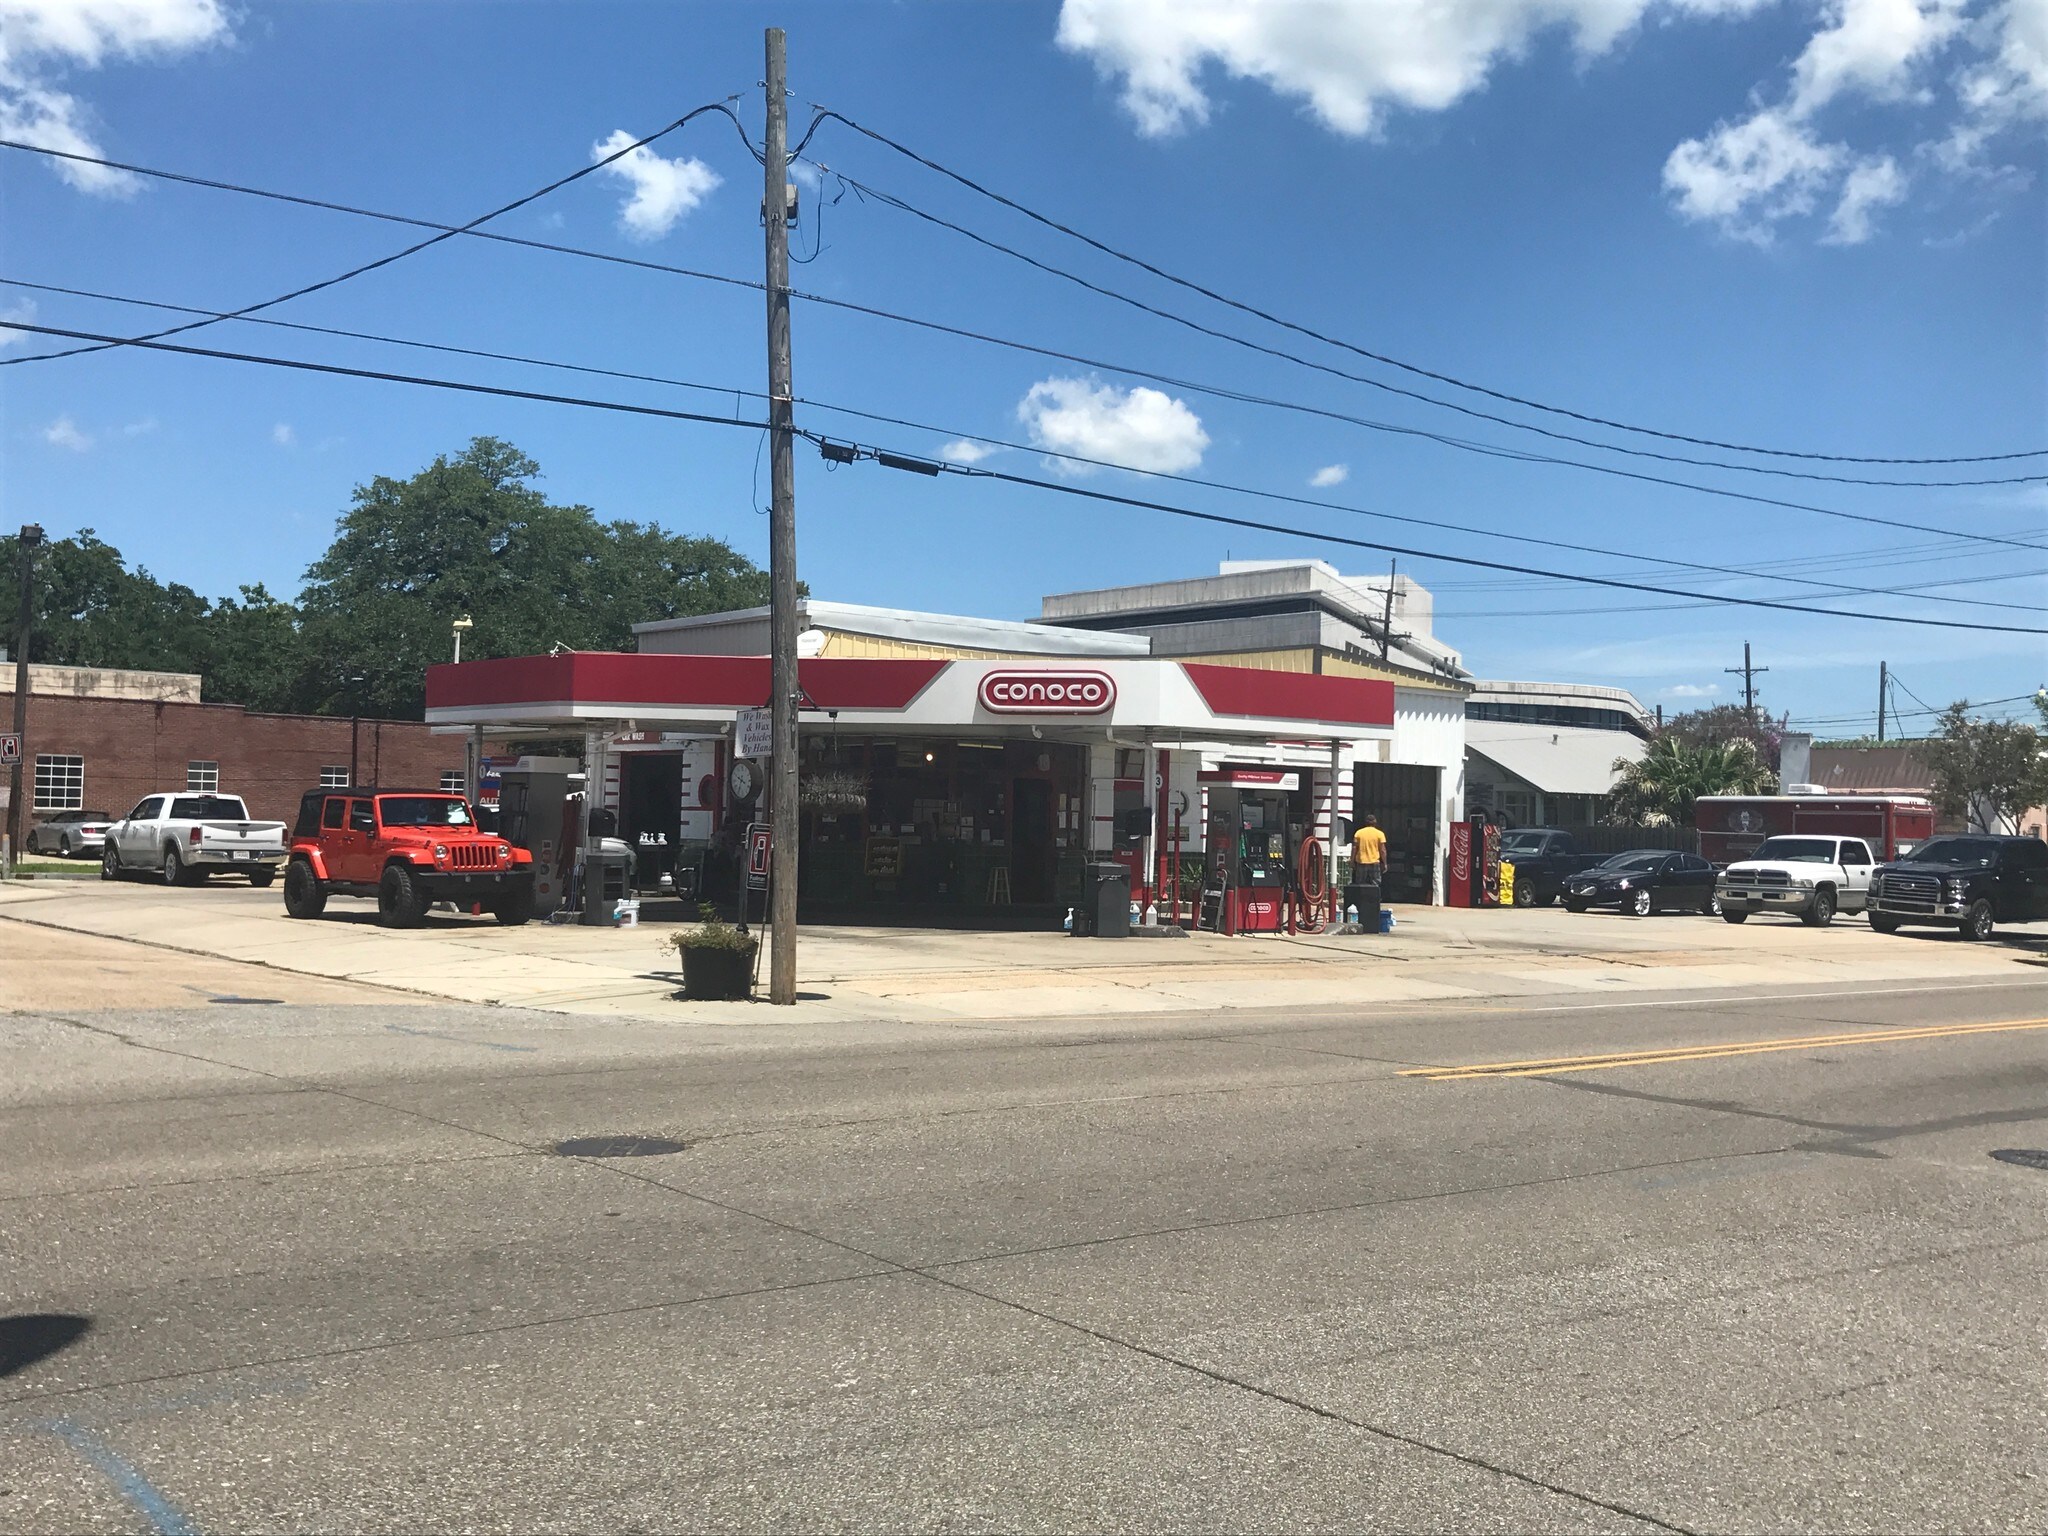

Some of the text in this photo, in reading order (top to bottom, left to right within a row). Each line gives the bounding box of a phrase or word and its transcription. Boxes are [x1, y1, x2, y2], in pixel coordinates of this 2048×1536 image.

[743, 712, 754, 721] We
[746, 722, 770, 732] & Wax
[744, 733, 772, 742] Vehicles
[742, 744, 752, 755] By
[1155, 776, 1161, 786] 3
